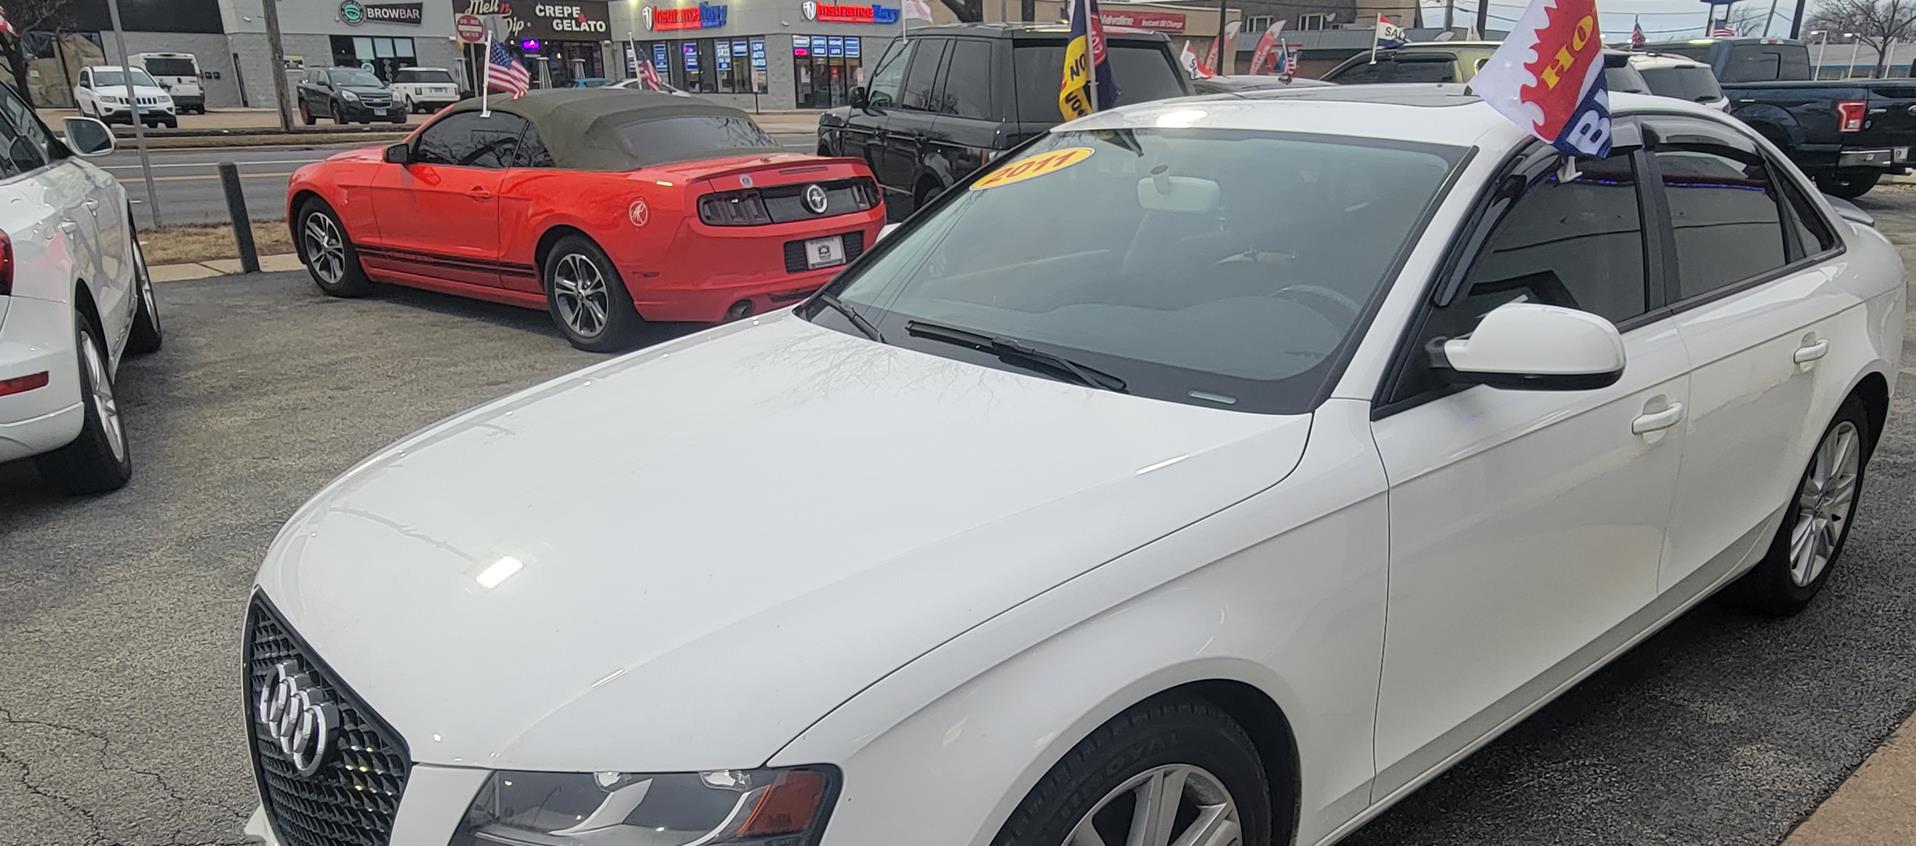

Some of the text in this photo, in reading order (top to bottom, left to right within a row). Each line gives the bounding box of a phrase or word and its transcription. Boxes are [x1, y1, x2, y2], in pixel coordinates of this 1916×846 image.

[535, 5, 581, 18] CREPE
[552, 19, 607, 32] GELATO
[1541, 15, 1594, 90] HO
[980, 150, 1078, 187] 2011
